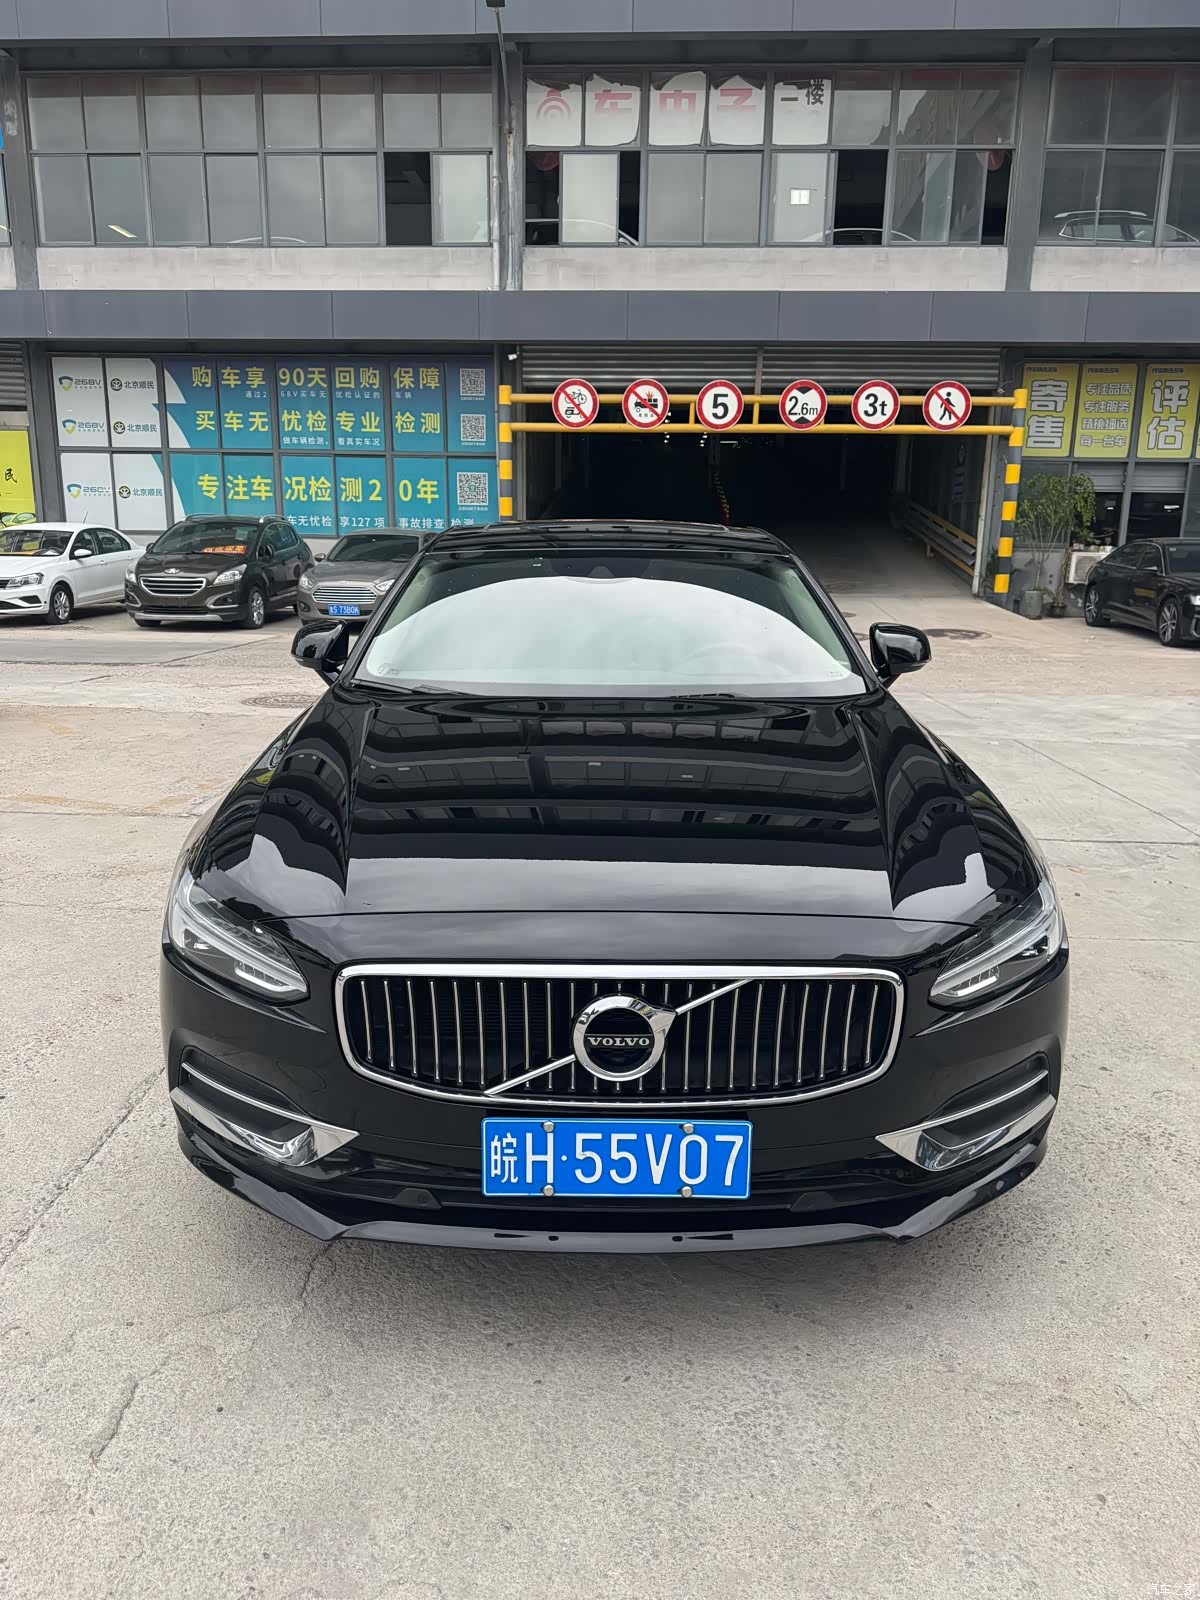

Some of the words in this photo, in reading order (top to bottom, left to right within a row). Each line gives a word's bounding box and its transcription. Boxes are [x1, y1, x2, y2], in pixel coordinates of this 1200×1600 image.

[1085, 383, 1133, 396] 专注品质
[712, 393, 729, 419] 5
[788, 395, 818, 416] 2.6m
[863, 393, 887, 417] 3t
[1083, 400, 1130, 413] 专注服务
[587, 1037, 650, 1047] VOLVO
